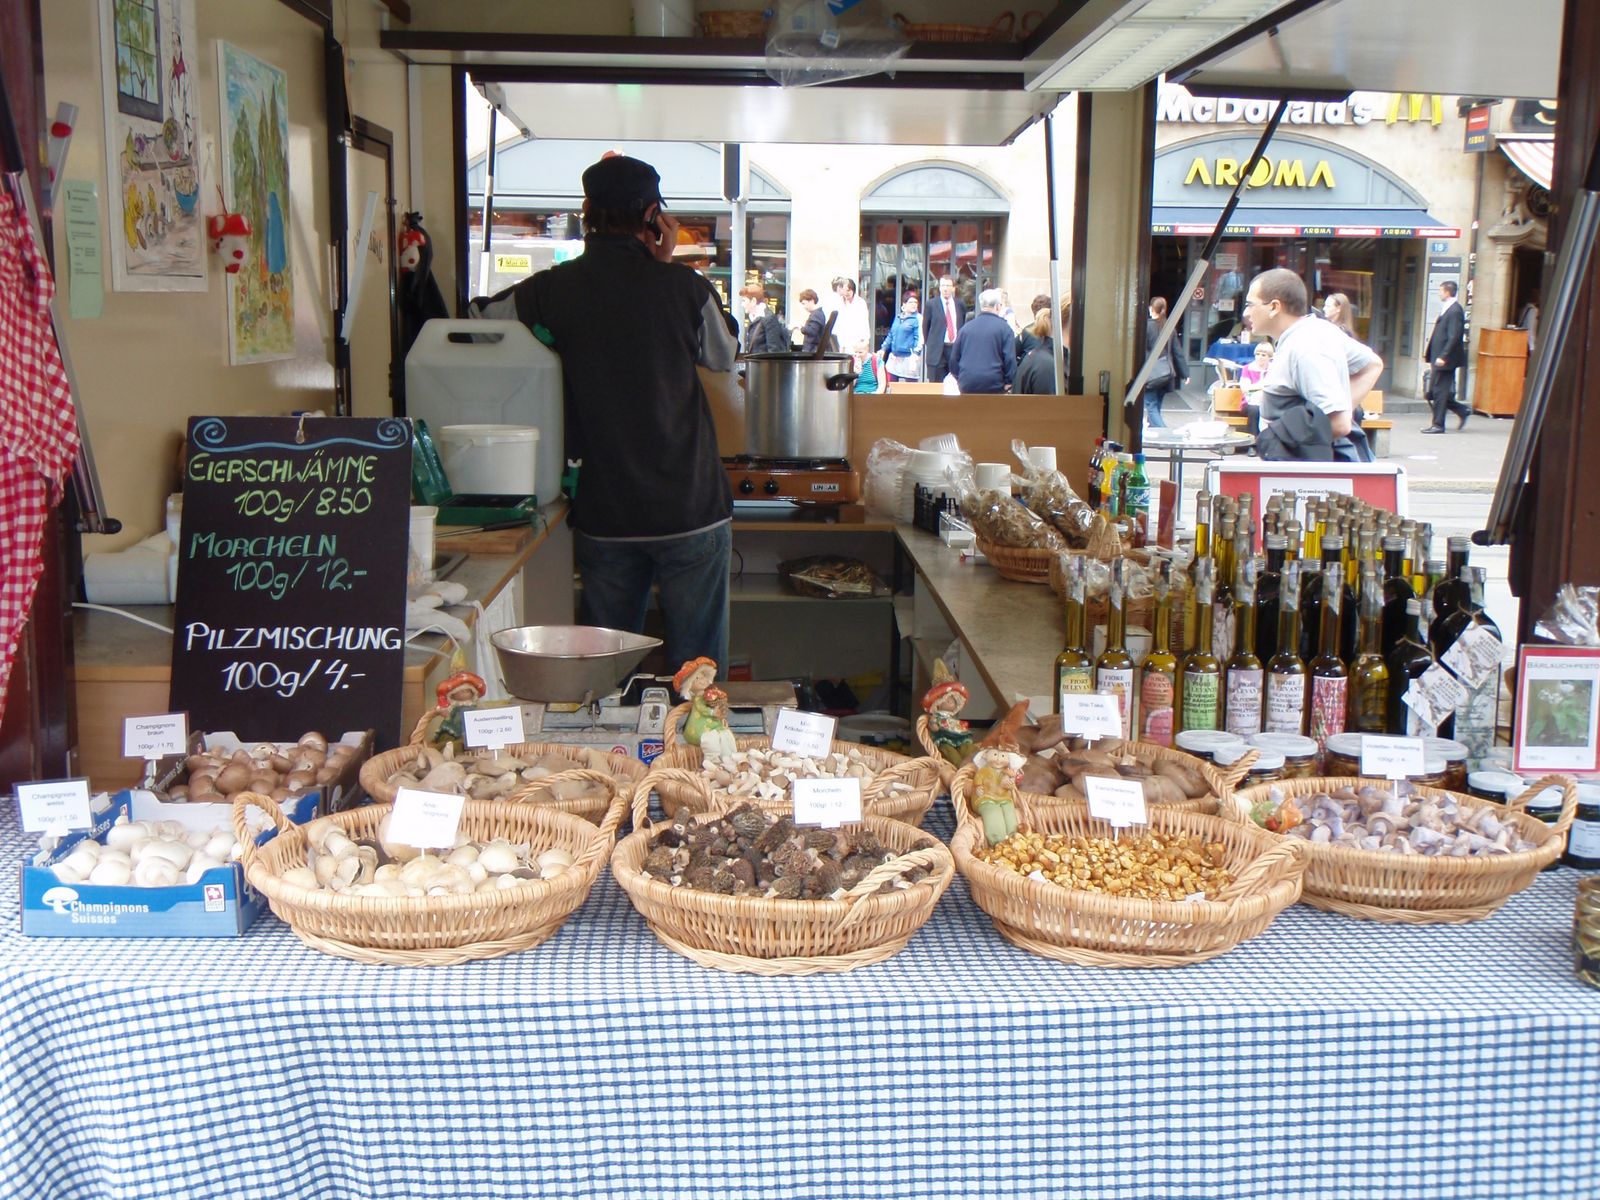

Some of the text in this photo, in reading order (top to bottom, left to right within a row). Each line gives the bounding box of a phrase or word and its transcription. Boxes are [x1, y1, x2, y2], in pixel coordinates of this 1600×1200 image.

[1184, 156, 1336, 190] AROMA
[188, 449, 378, 484] EIERSCHWÄMME
[189, 531, 337, 559] MORCHELN
[185, 622, 402, 651] PILZMISCHUNG
[70, 900, 149, 914] Champignons
[71, 913, 117, 924] Suisses
